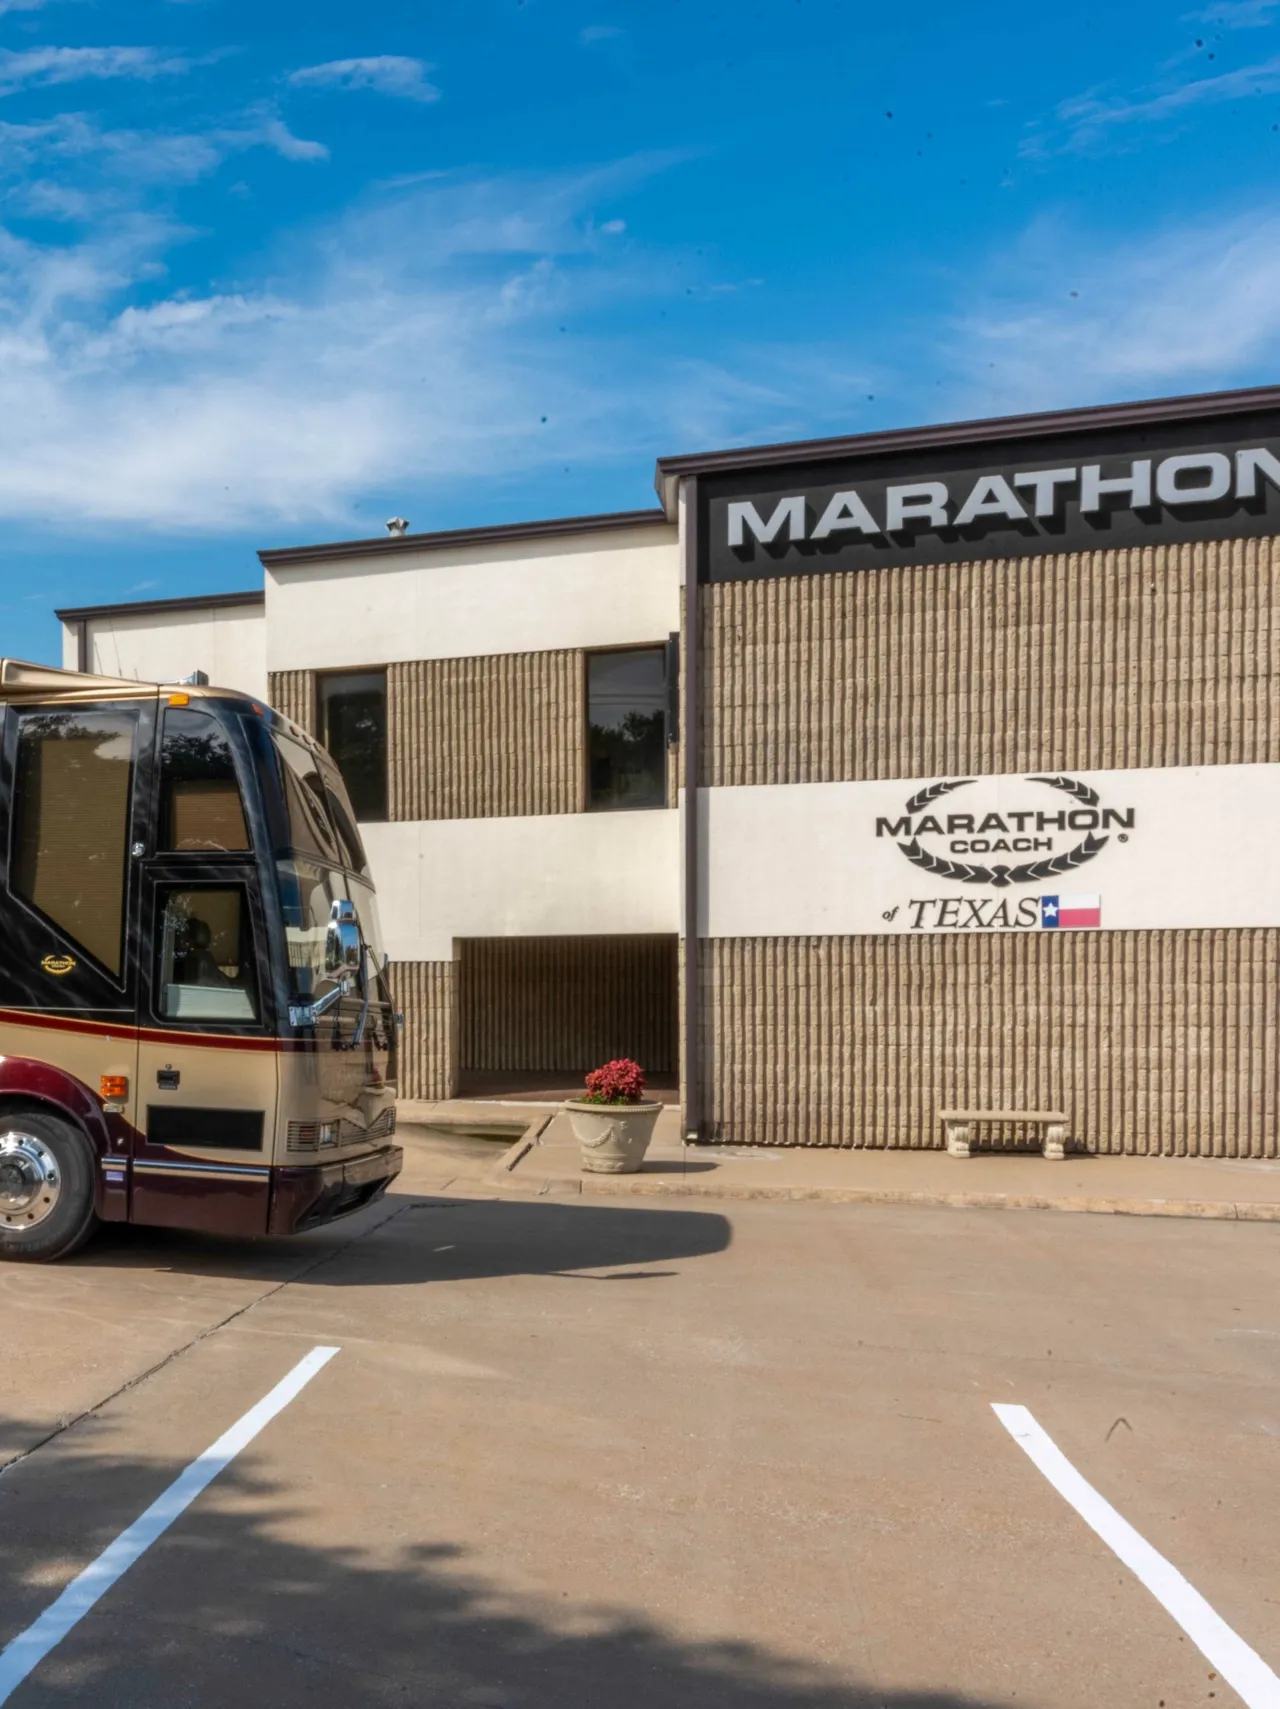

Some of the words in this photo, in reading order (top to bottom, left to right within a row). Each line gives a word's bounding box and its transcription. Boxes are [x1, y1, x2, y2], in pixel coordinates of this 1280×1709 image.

[728, 448, 1280, 546] MARATHON
[875, 807, 1135, 838] MARATHON
[949, 837, 1053, 854] COACH
[881, 905, 899, 923] of
[907, 895, 1041, 929] TEXAS
